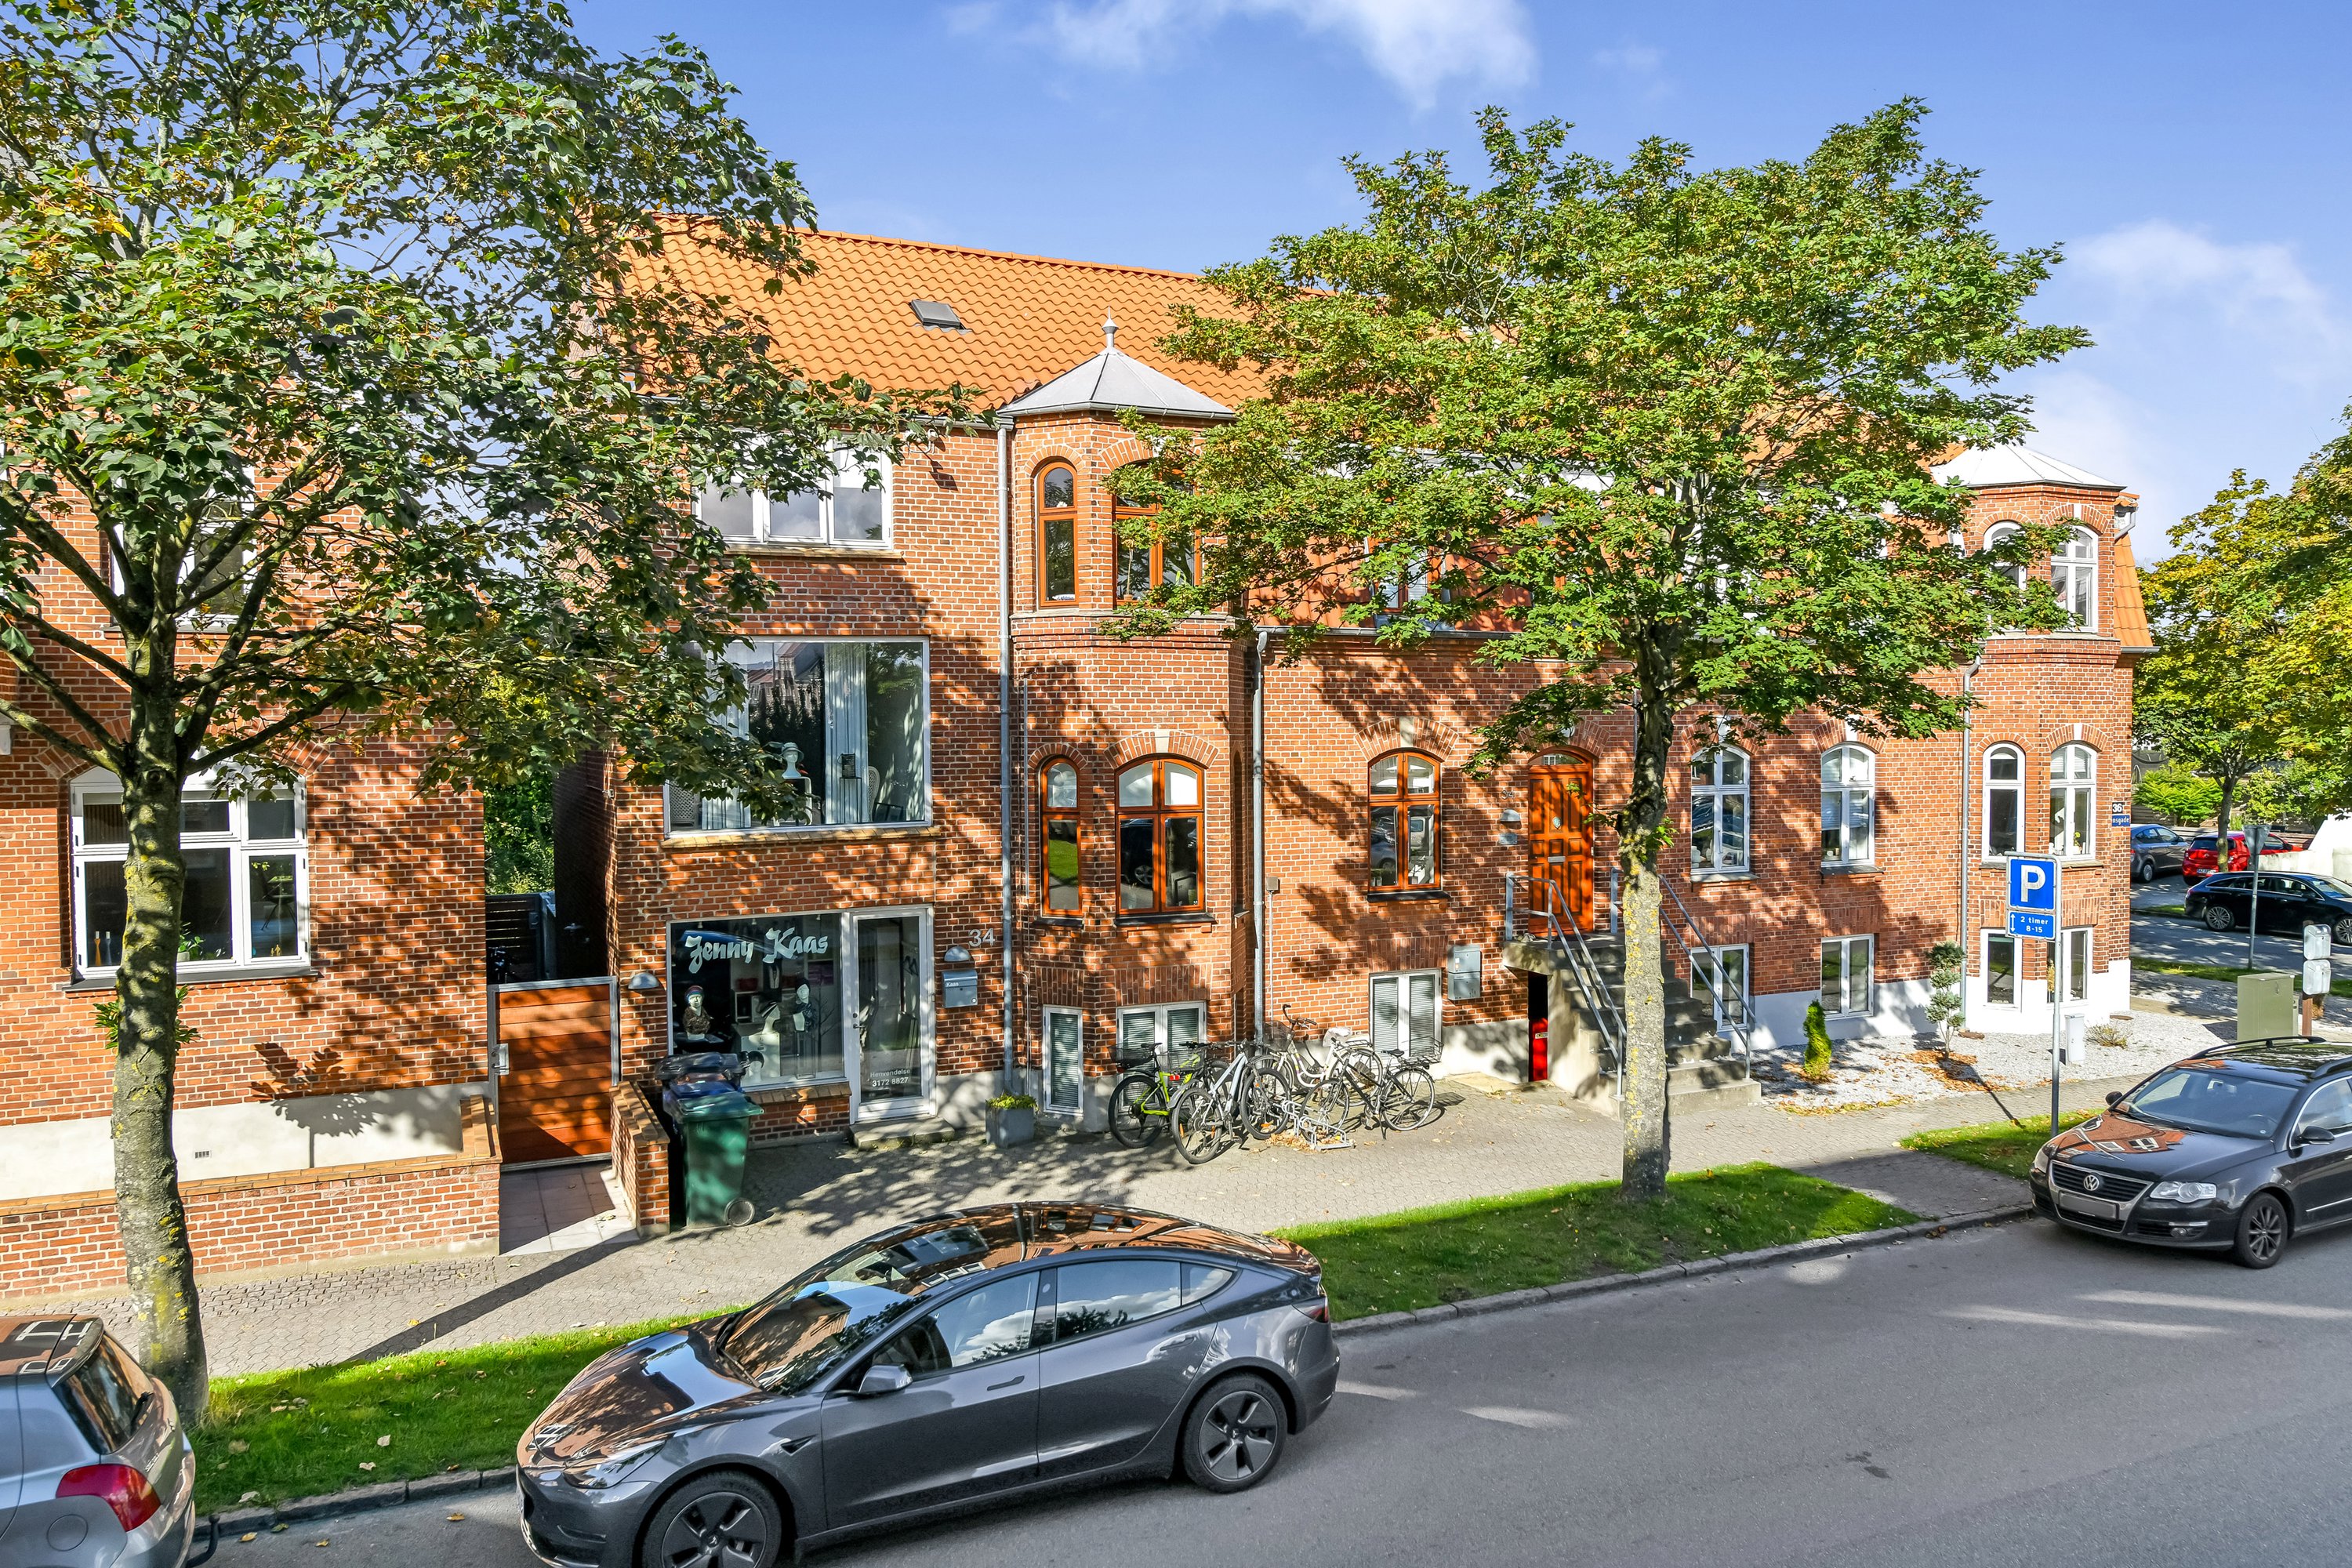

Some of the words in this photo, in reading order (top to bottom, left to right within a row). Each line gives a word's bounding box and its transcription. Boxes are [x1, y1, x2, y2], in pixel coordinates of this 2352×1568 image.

[2112, 803, 2122, 813] 36
[2021, 865, 2046, 902] P
[968, 927, 996, 947] 34
[684, 935, 754, 974] Jenny
[762, 927, 829, 964] Kaas
[870, 1069, 910, 1078] Henvendelse
[872, 1079, 890, 1087] 3172
[891, 1076, 909, 1085] 8827
